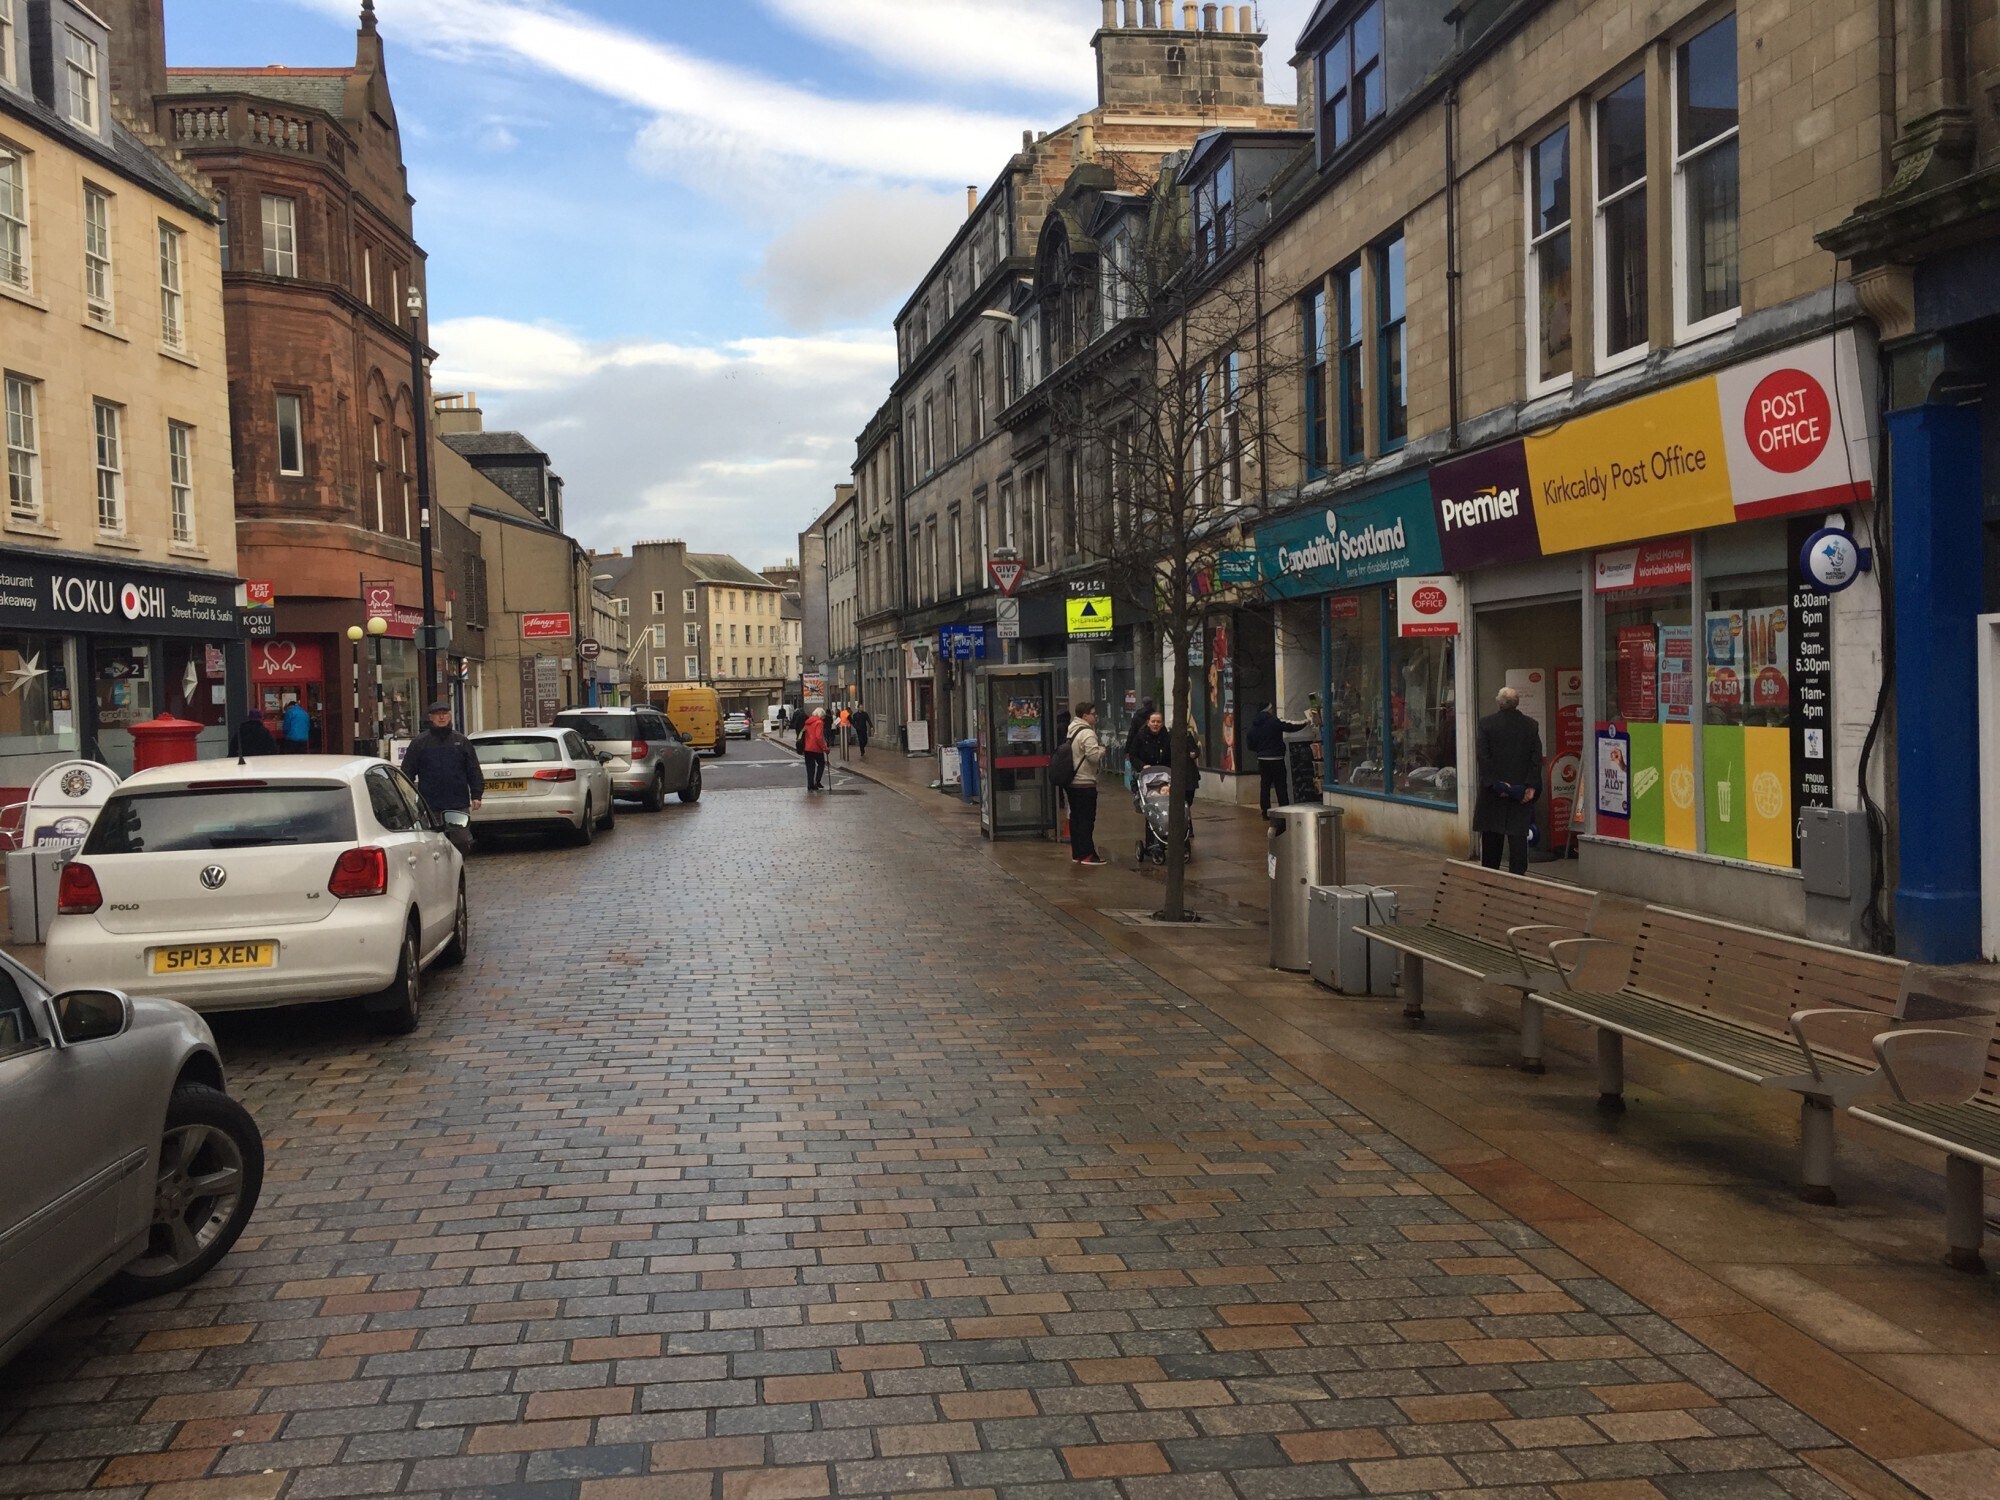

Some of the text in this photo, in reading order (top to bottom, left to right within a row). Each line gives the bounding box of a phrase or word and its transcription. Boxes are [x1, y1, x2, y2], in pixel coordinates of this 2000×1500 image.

[1761, 389, 1807, 422] POST
[1760, 417, 1821, 453] OFFICE
[1543, 444, 1706, 505] Kirkcaldy Post Office
[1441, 486, 1520, 531] Premier
[1278, 516, 1406, 577] Capability Scotland
[1645, 549, 1685, 562] Send Money
[996, 565, 1017, 573] GIVE
[1346, 567, 1358, 578] here
[1367, 560, 1390, 574] disabled
[1391, 556, 1410, 574] people
[1639, 564, 1674, 577] Worldwide
[1674, 562, 1692, 573] Here
[250, 584, 269, 592] JUST
[1069, 580, 1105, 591] TO LET
[51, 576, 165, 620] KOKU OSHI
[187, 591, 217, 606] Japanese
[1420, 591, 1440, 600] POST
[1793, 593, 1831, 608] 8.30am-
[1415, 600, 1444, 608] OFFICE
[172, 606, 233, 622] Street Food & Sushi
[243, 616, 271, 625] KOKU
[1802, 610, 1822, 627] 6pm
[250, 626, 271, 634] OSHI
[1801, 641, 1825, 655] 9am-
[131, 664, 140, 675] 2
[1796, 658, 1830, 674] 5.30pm
[1712, 681, 1737, 695] £3.50
[1761, 679, 1780, 695] 99p
[1800, 687, 1826, 700] 11am-
[1802, 703, 1824, 719] 4pm
[1604, 768, 1618, 779] WIN
[1805, 773, 1824, 783] PROUD
[484, 780, 524, 791] SN67 XNM
[1802, 784, 1829, 795] TO SERVE
[167, 946, 259, 968] SP13 XEN
